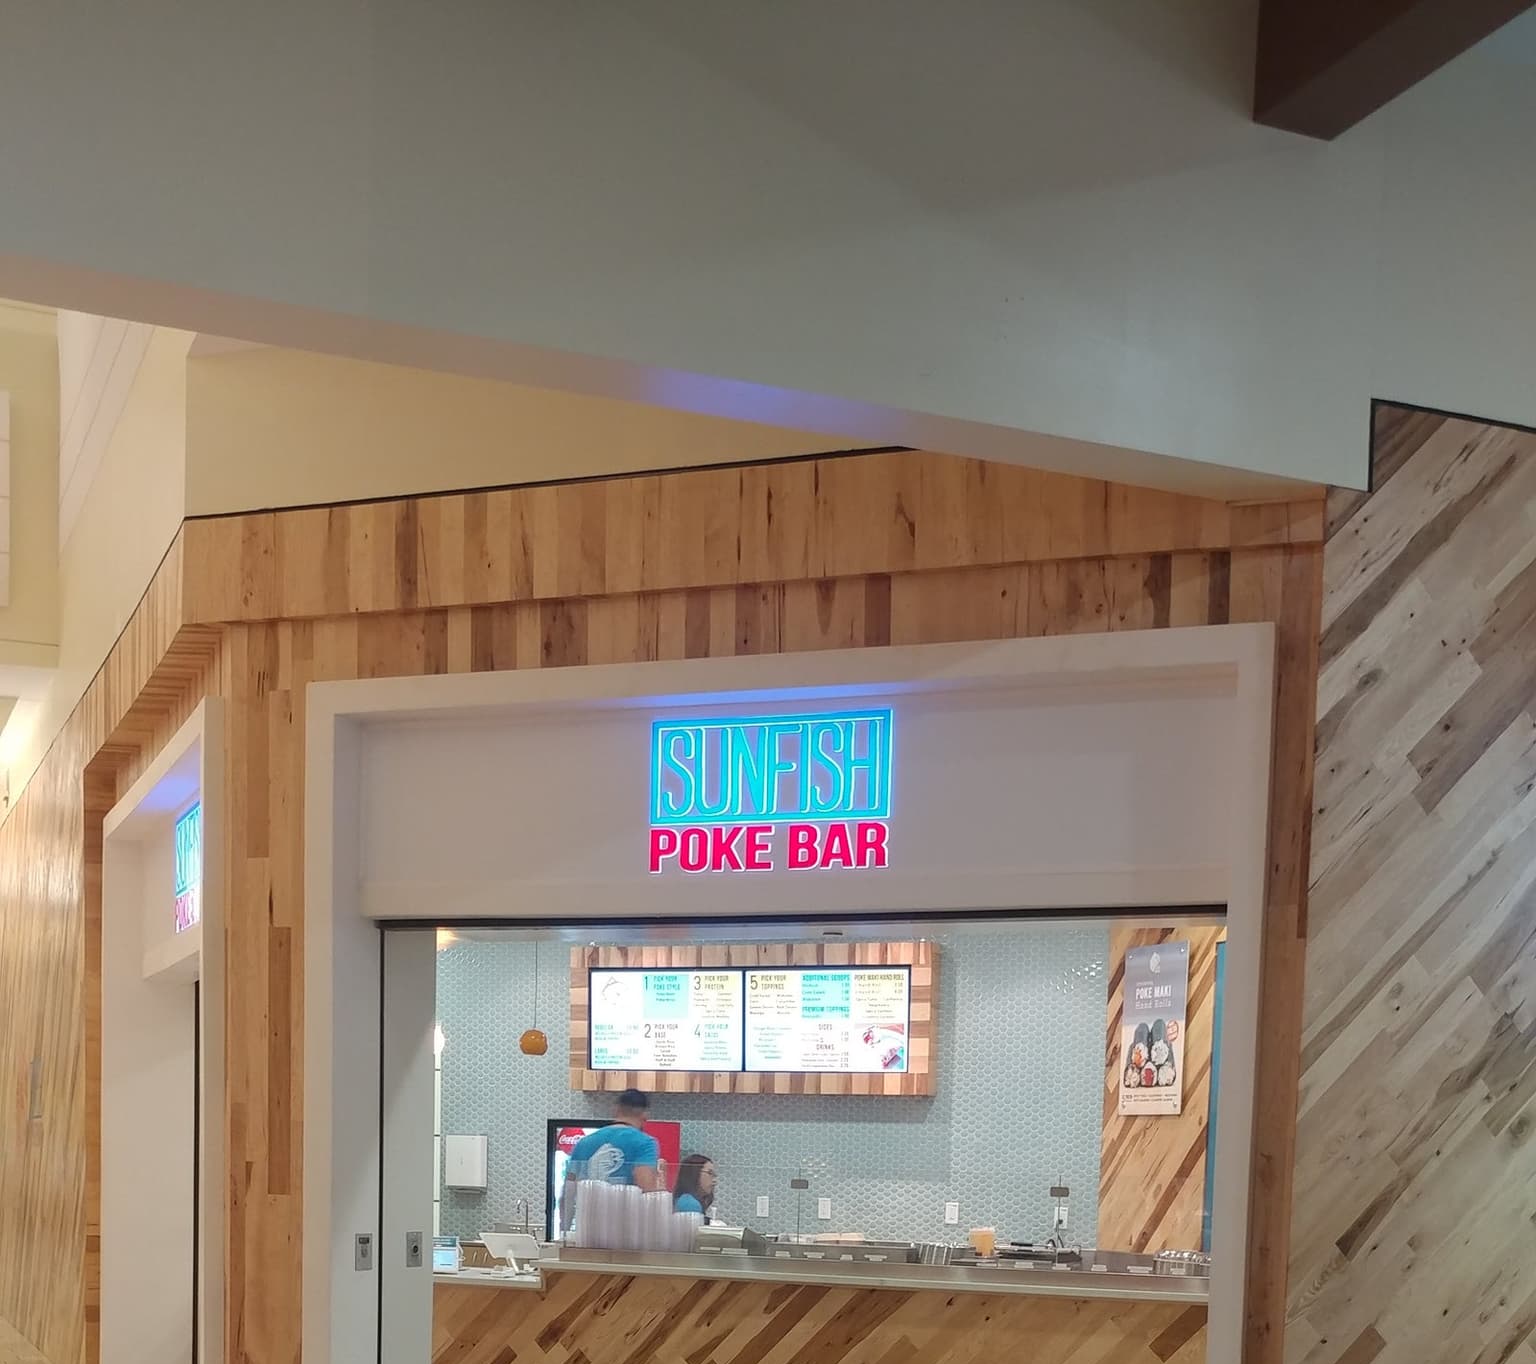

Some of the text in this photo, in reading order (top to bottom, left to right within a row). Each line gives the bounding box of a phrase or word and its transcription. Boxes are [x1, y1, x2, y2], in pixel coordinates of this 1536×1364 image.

[658, 715, 886, 819] SUNFISH
[649, 821, 889, 874] POKE BAR
[694, 975, 702, 991] 3
[750, 974, 758, 991] 5
[1135, 987, 1152, 1000] POKE
[1154, 984, 1171, 998] MAKI
[644, 1023, 652, 1039] 2
[694, 1023, 701, 1039] 4
